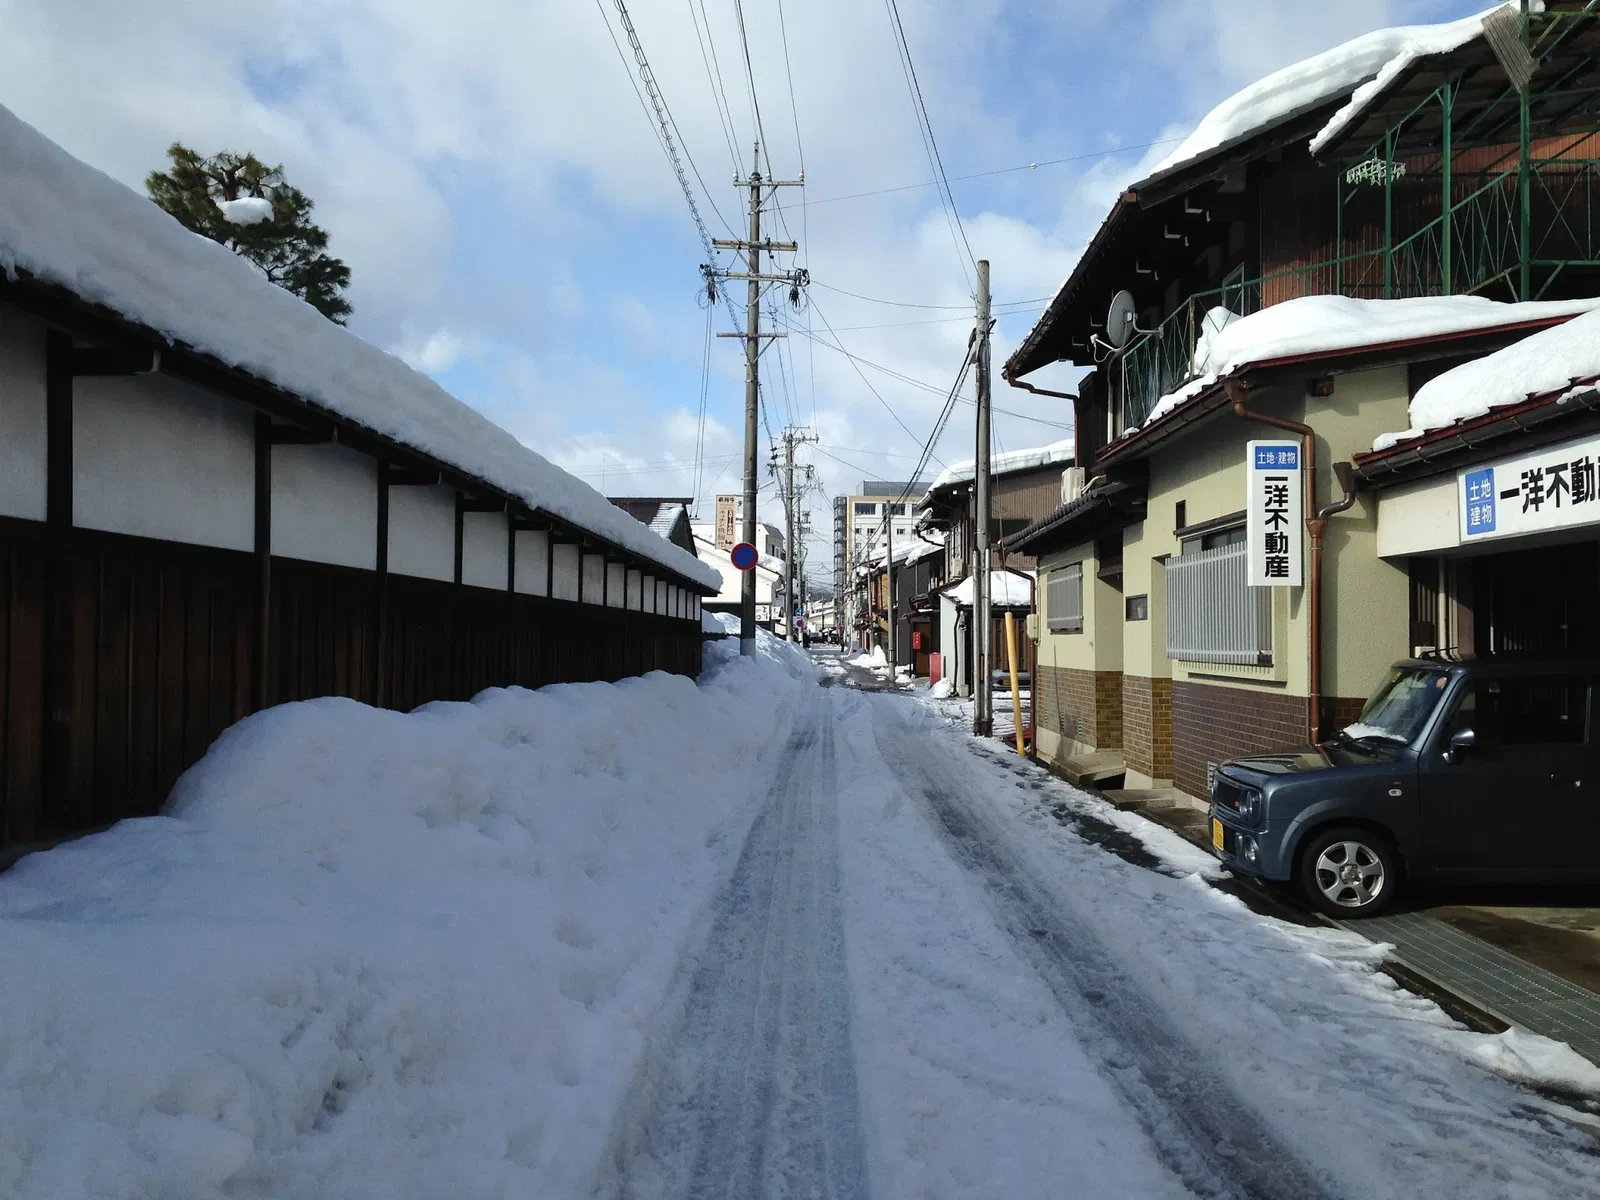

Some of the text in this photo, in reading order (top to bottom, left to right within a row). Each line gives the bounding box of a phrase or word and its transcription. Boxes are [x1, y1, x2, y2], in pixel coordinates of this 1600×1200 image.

[1470, 478, 1491, 502] 土地
[1500, 456, 1600, 514] 一洋不動
[1265, 476, 1289, 577] 一洋不動産
[1470, 504, 1492, 526] 建物
